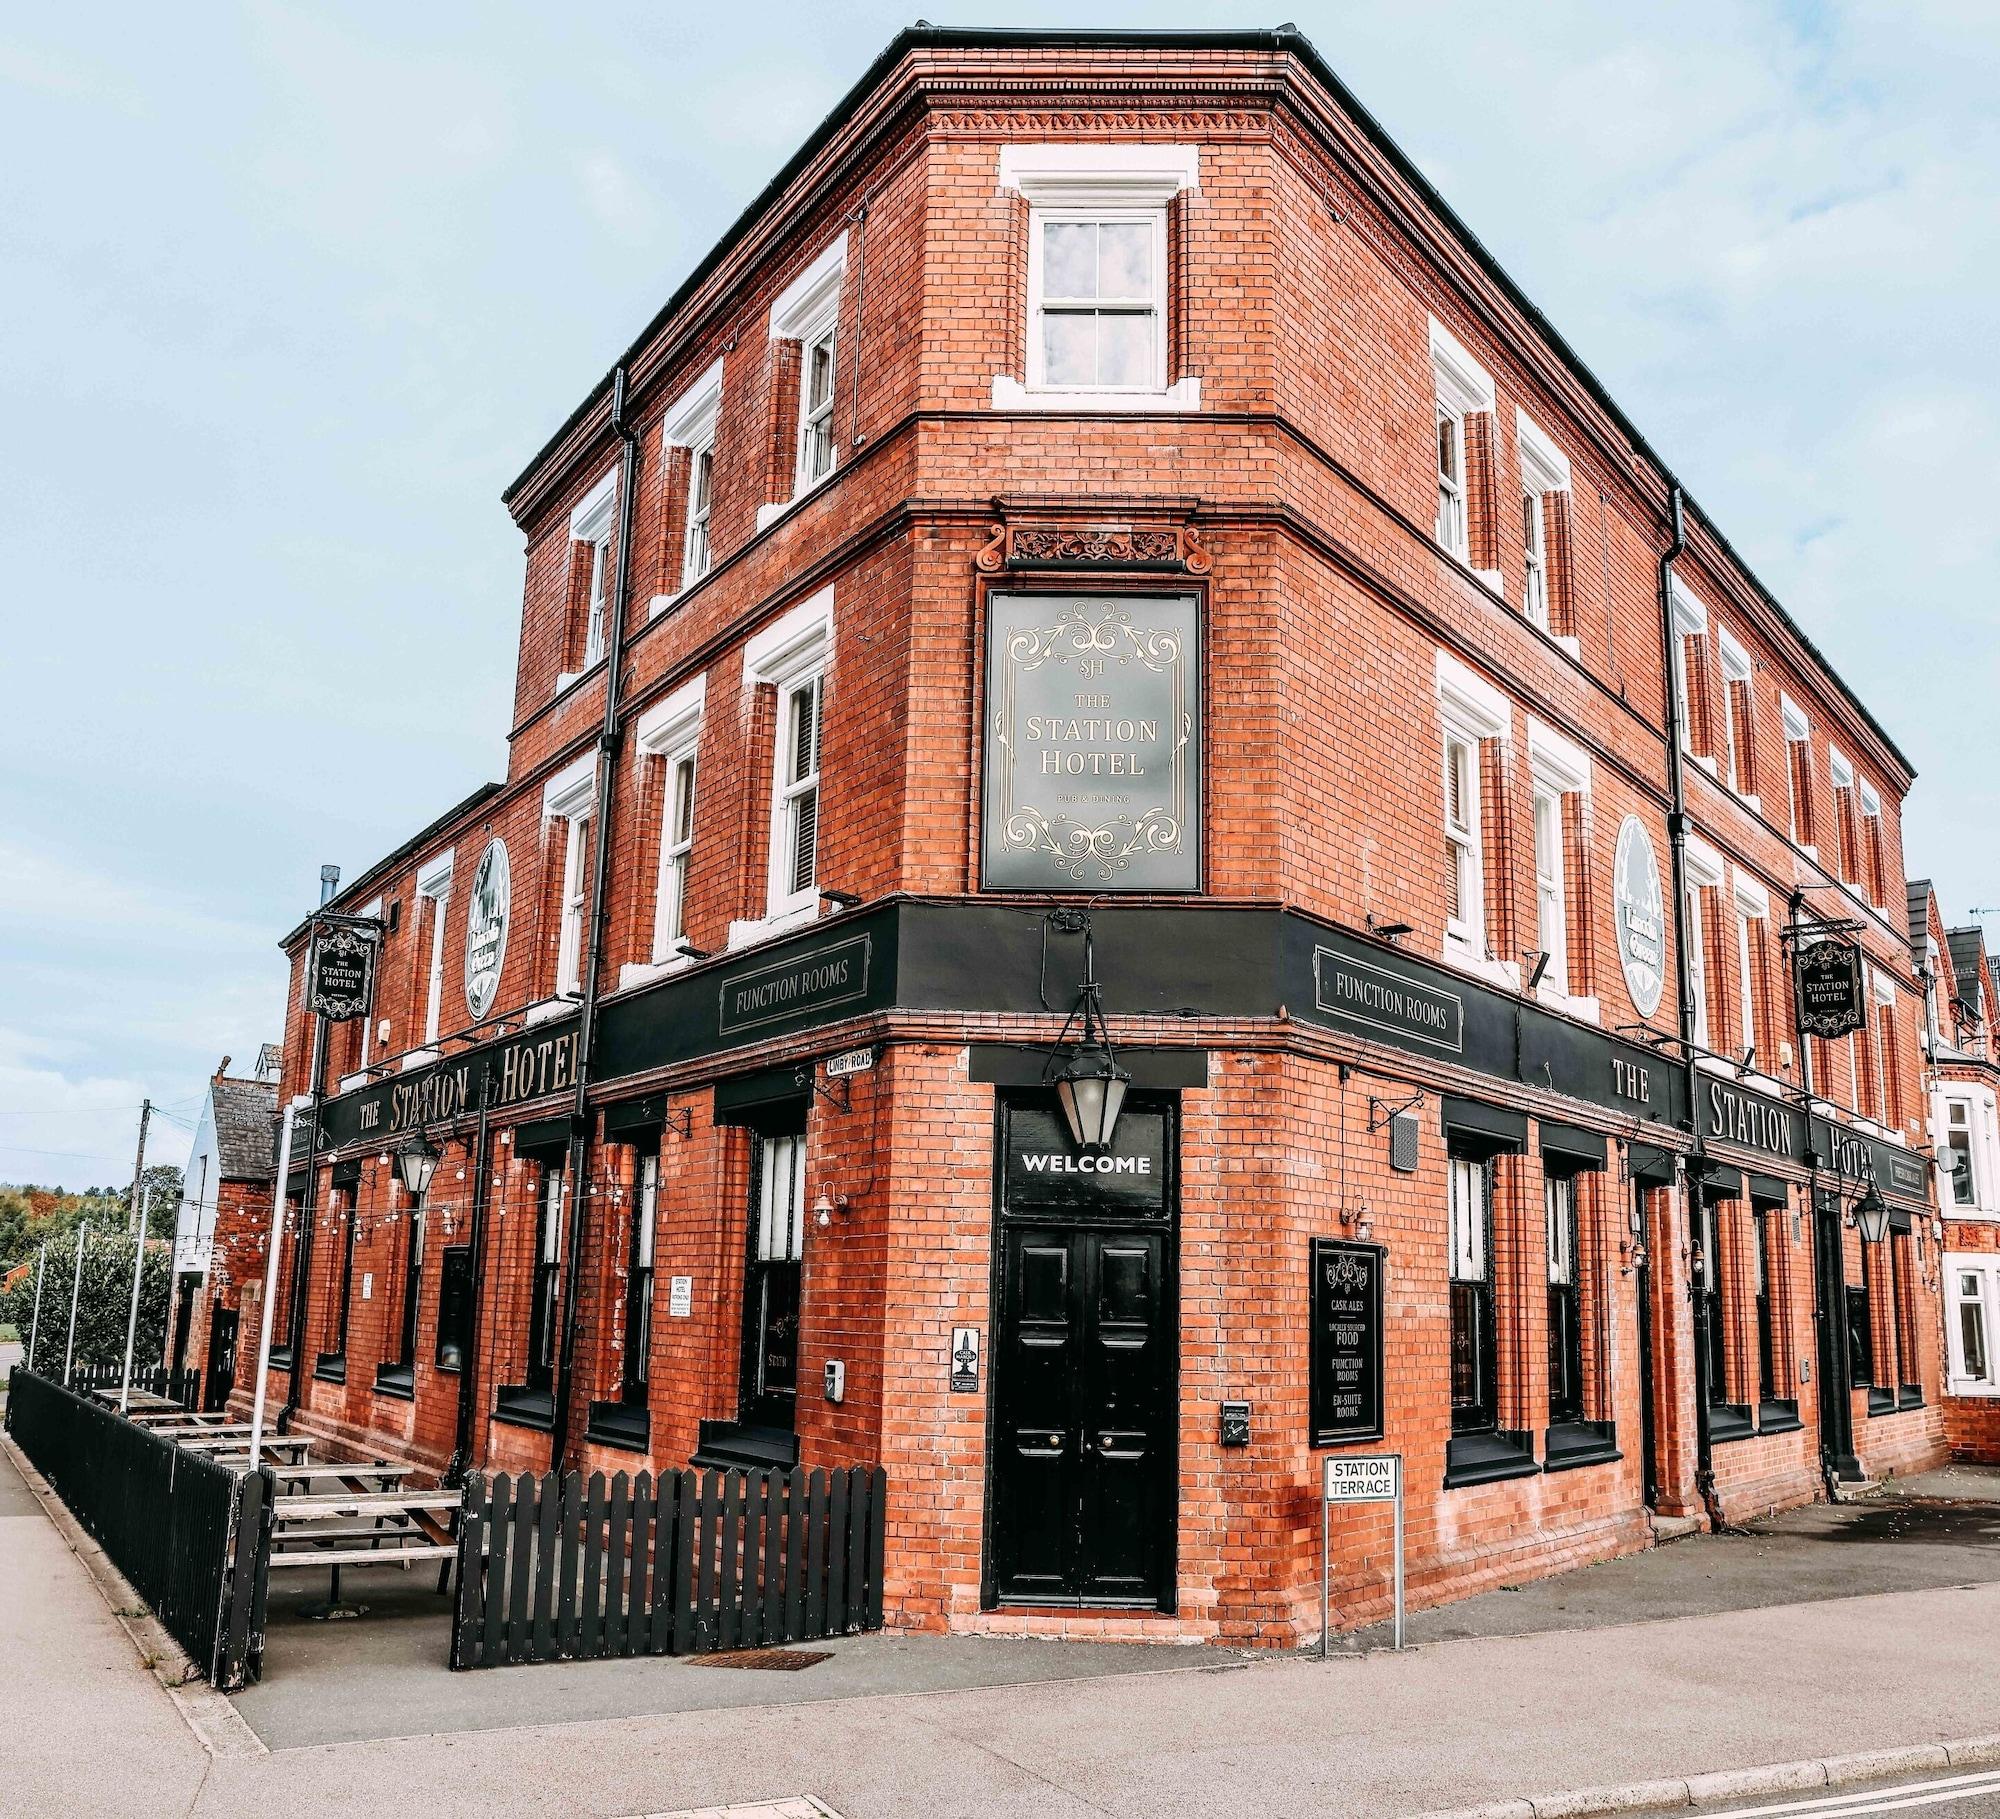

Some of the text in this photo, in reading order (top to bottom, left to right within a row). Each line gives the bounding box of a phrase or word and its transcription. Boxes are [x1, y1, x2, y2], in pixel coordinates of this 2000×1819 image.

[1074, 694, 1110, 708] THE
[1025, 716, 1158, 742] STATION
[1040, 749, 1145, 775] HOTEL
[1057, 794, 1130, 803] PUB & DINING
[321, 966, 361, 978] STATION
[325, 977, 356, 988] HOTEL
[736, 959, 849, 1014] FUNCTION ROOMS
[1806, 981, 1849, 992] STATION
[1336, 972, 1447, 1030] FUNCTION ROOMS
[1811, 992, 1846, 1003] HOTEL
[852, 1052, 871, 1068] ROAD
[360, 1100, 380, 1130] THE
[390, 1067, 469, 1131] STATION
[1612, 1058, 1877, 1182] THE STATION HOTEL
[1022, 1154, 1151, 1174] WELCOME
[1331, 1300, 1364, 1311] CASK ALES
[1336, 1332, 1359, 1345] FOOD
[1331, 1359, 1363, 1369] FUNCTION
[1337, 1370, 1359, 1381] ROOMS
[1333, 1394, 1362, 1406] EN-SUITE
[1337, 1406, 1359, 1418] ROOMS
[1335, 1462, 1389, 1476] STATION
[1333, 1479, 1391, 1494] TERRACE
